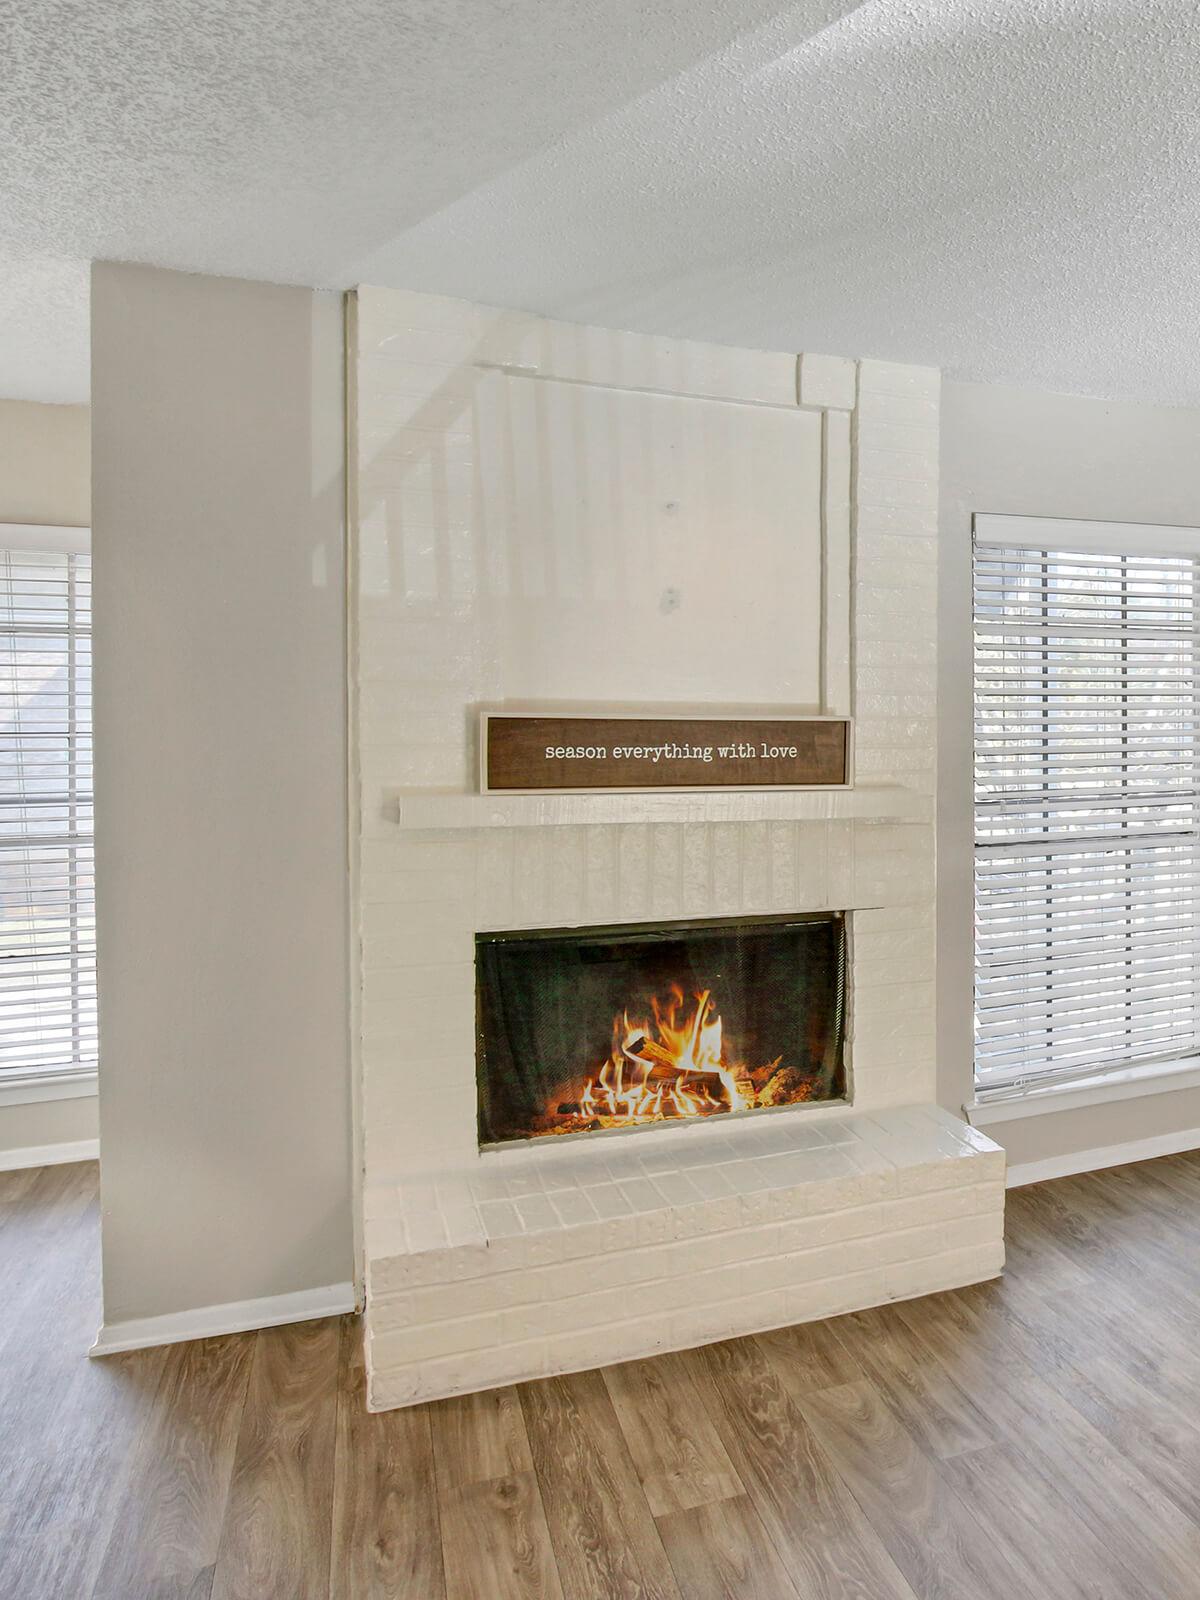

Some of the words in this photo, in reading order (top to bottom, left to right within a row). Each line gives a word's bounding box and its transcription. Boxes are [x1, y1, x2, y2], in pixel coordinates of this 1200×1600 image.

[545, 745, 607, 759] season
[612, 743, 714, 763] everything
[717, 742, 757, 759] with
[760, 742, 798, 759] love
